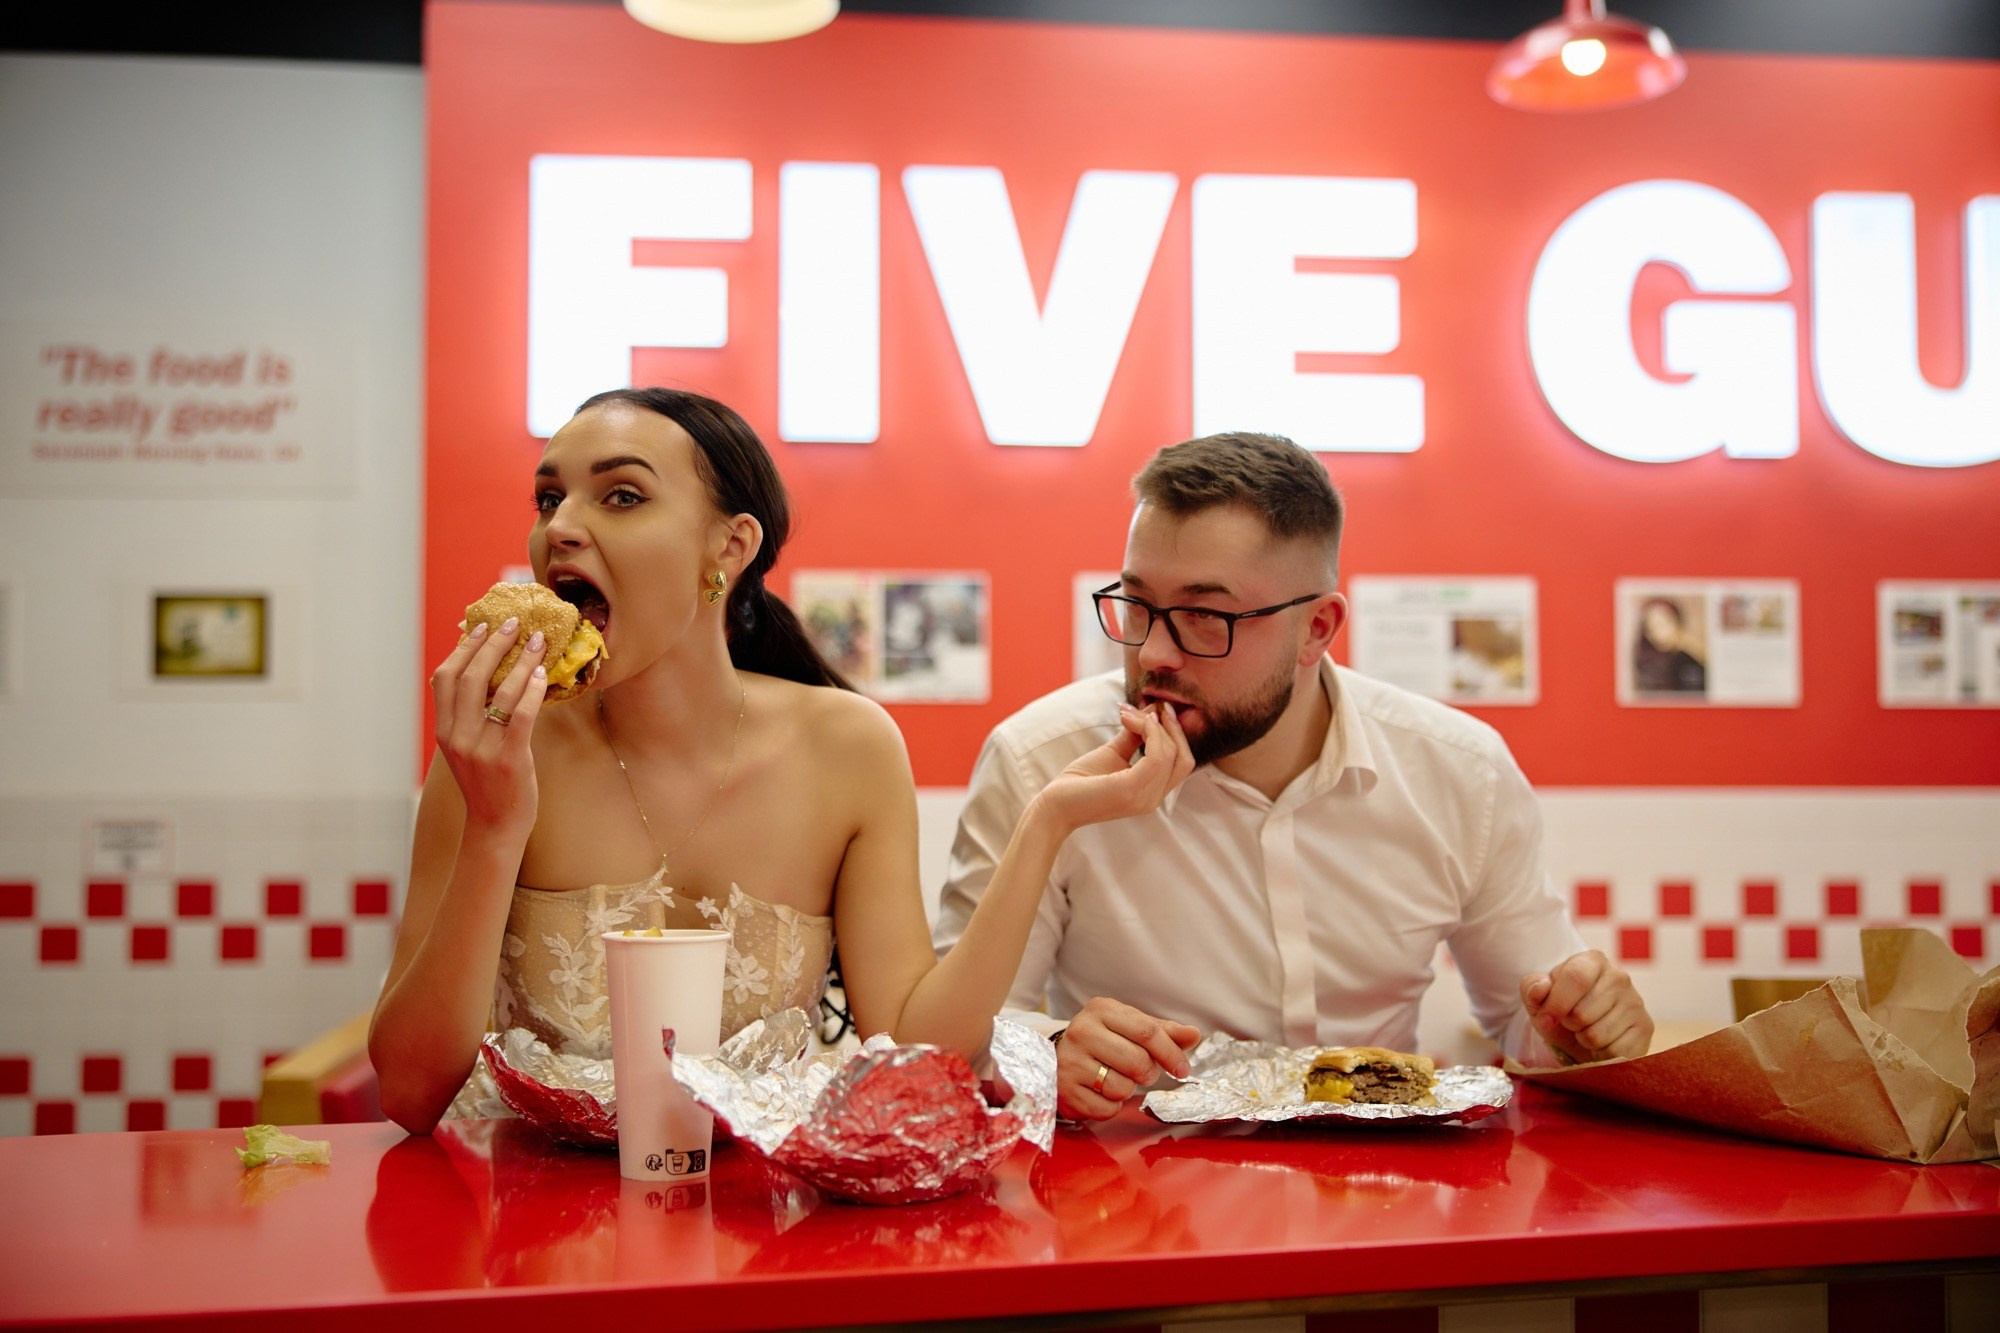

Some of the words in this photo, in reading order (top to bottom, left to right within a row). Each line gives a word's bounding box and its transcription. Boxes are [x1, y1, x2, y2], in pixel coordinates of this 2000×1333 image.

[528, 153, 1424, 454] FIVE
[1527, 178, 2000, 468] GU
[41, 345, 136, 385] "The
[149, 345, 246, 386] food
[258, 346, 293, 384] is
[37, 396, 162, 440] really
[168, 396, 297, 439] good"
